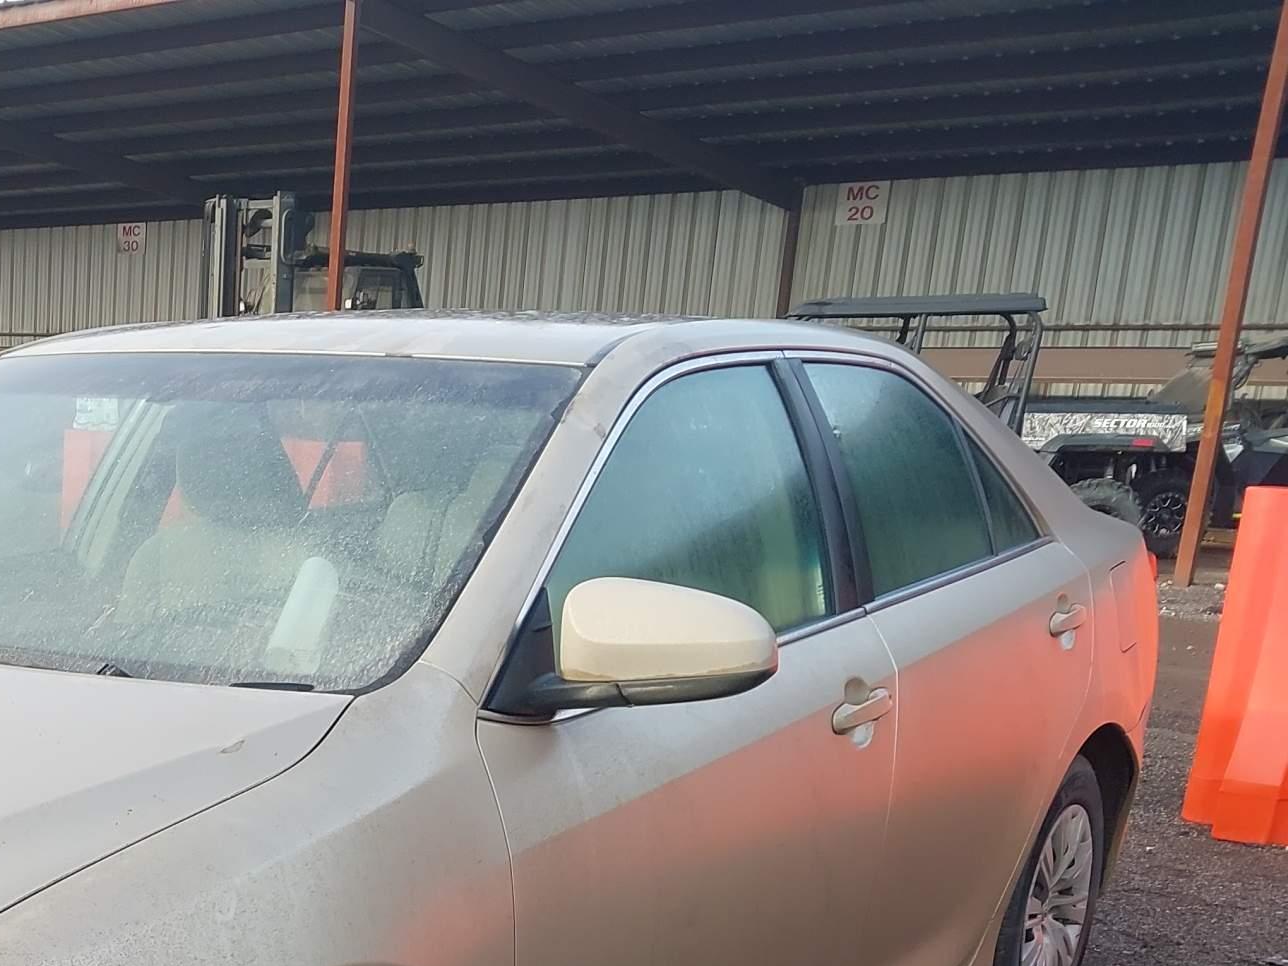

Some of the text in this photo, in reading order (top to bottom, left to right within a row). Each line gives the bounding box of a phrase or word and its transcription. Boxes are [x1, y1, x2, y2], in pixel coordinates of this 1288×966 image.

[847, 185, 880, 200] MC
[847, 206, 874, 221] 20
[122, 225, 141, 237] MC
[123, 241, 139, 252] 30
[1094, 418, 1147, 428] SECTOR
